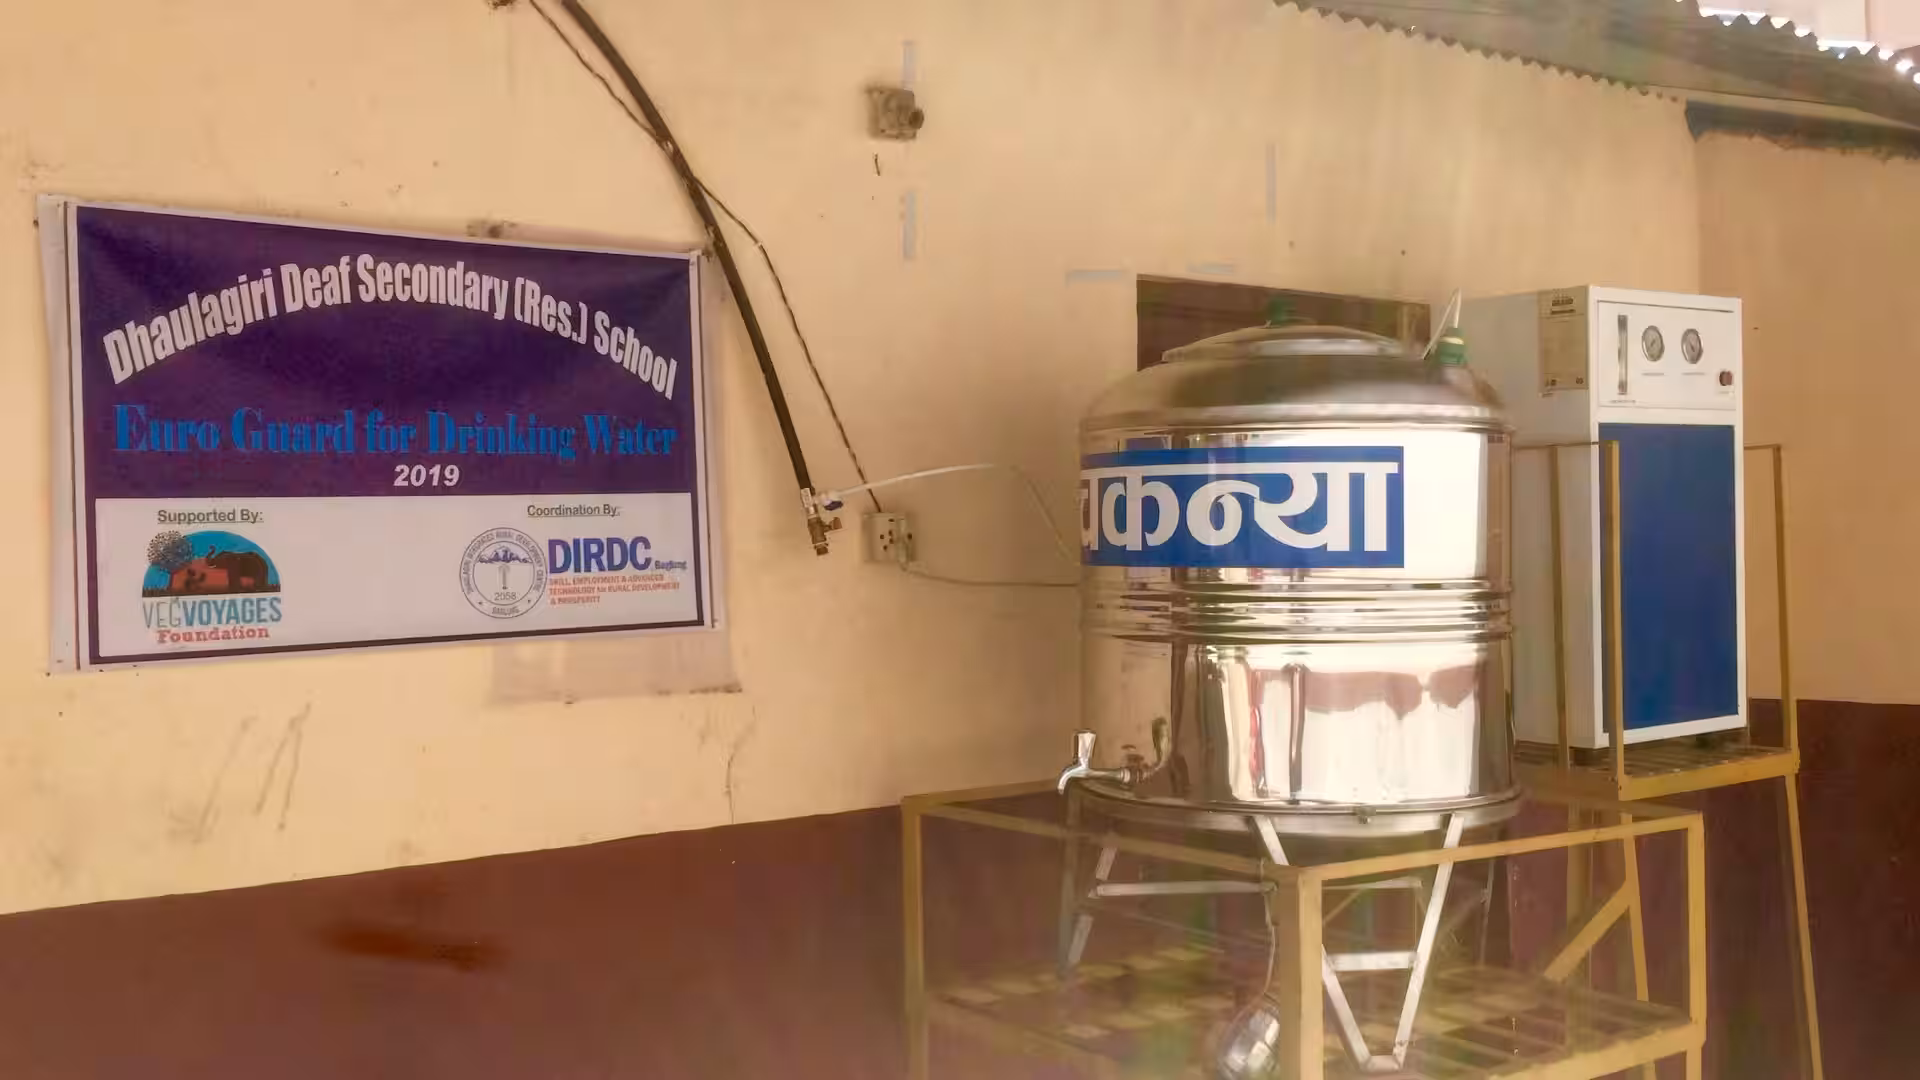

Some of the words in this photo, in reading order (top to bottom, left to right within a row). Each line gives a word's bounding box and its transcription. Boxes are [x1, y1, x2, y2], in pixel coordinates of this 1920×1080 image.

[103, 268, 278, 385] Dhaulagiri
[280, 255, 351, 313] Deaf
[356, 253, 509, 320] Secondary
[514, 277, 588, 345] (Res.)
[593, 310, 677, 401] School
[112, 404, 219, 452] Euro
[231, 406, 355, 453] Guard
[364, 409, 416, 453] for
[426, 410, 577, 460] Drinking
[583, 413, 677, 456] Water
[393, 464, 460, 487] 2019
[158, 509, 236, 524] Supported
[241, 508, 263, 524] By:
[527, 504, 601, 516] Coordination
[603, 504, 621, 517] By:
[548, 536, 652, 574] DIRDC
[549, 586, 595, 595] TECHNOLOGY
[632, 582, 680, 592] DEVELOPMENT
[573, 575, 620, 585] EMPLOYMENT
[157, 627, 270, 644] Foundation
